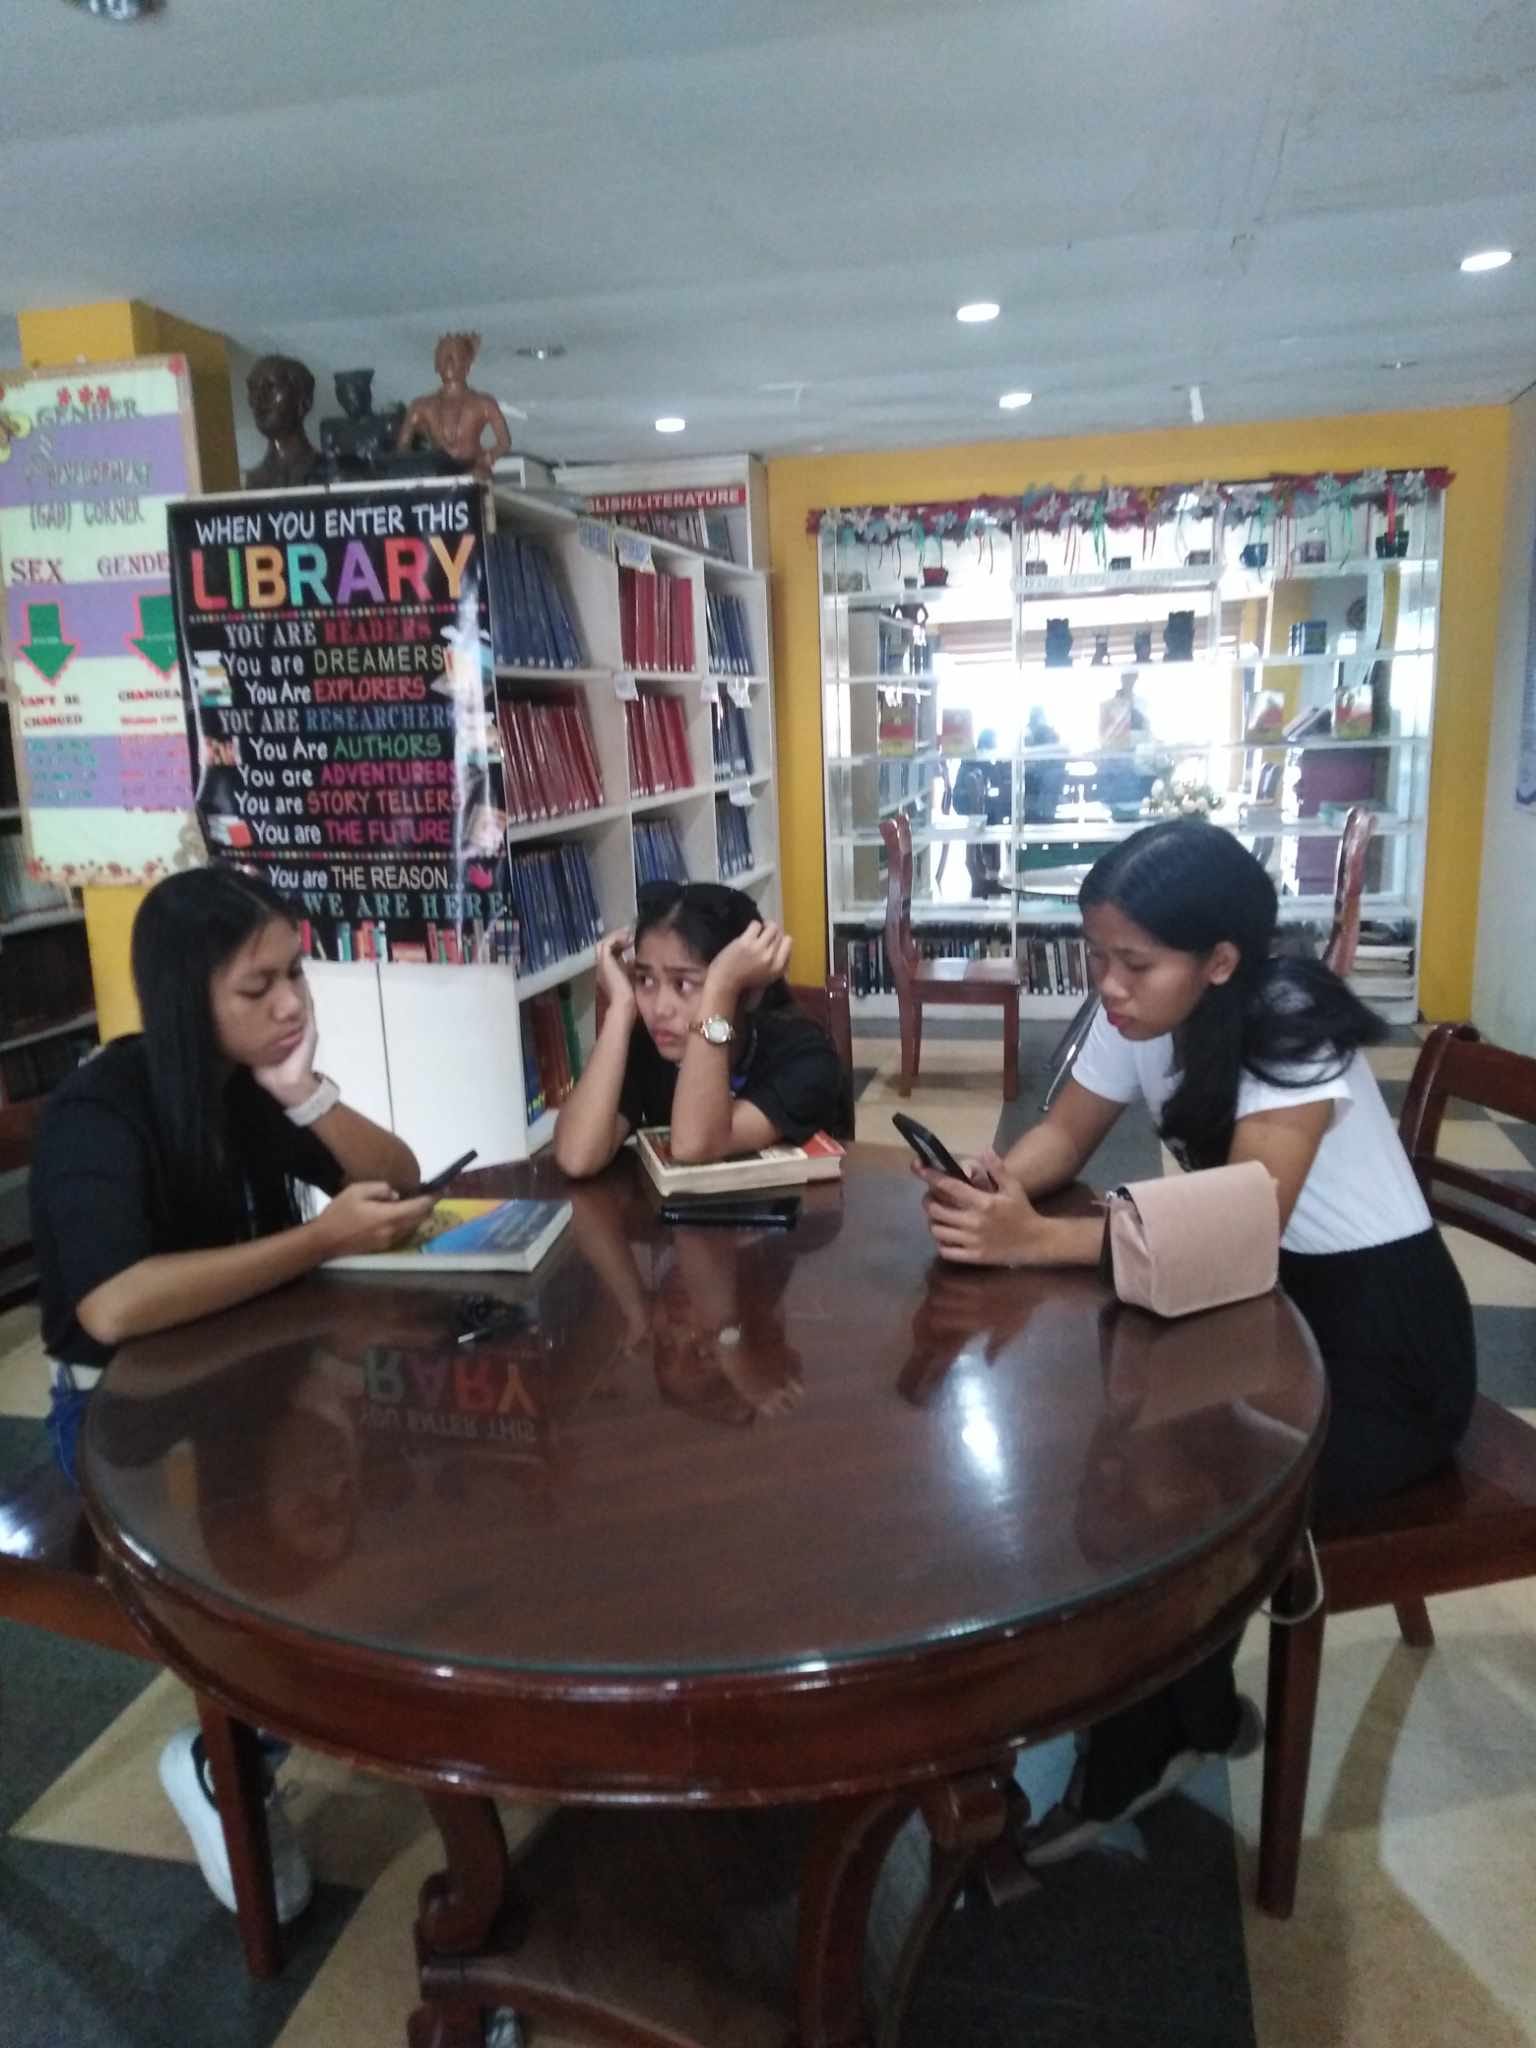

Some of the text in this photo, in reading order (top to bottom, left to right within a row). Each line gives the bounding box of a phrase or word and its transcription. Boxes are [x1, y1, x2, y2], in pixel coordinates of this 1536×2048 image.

[194, 501, 469, 545] WHEN YOU ENTER THIS
[10, 557, 65, 584] SEX
[97, 551, 169, 577] GENDE
[190, 533, 475, 611] LIBRARY
[224, 617, 432, 648] YOU ARE READERS
[223, 644, 444, 677] You are DREAMERS
[245, 674, 426, 704] You Are EXPLORERS
[217, 709, 255, 734] YOU
[261, 707, 299, 733] ARE
[250, 733, 441, 761] You Are AUTHORS
[237, 759, 458, 787] You are ADVENTURERS
[234, 788, 462, 816] You are STORY TELLERS
[252, 819, 451, 846] You are THE FUTURE
[268, 864, 299, 889] You
[303, 869, 328, 889] are
[330, 866, 367, 890] THE
[303, 892, 344, 918] WE
[356, 892, 410, 919] ARE
